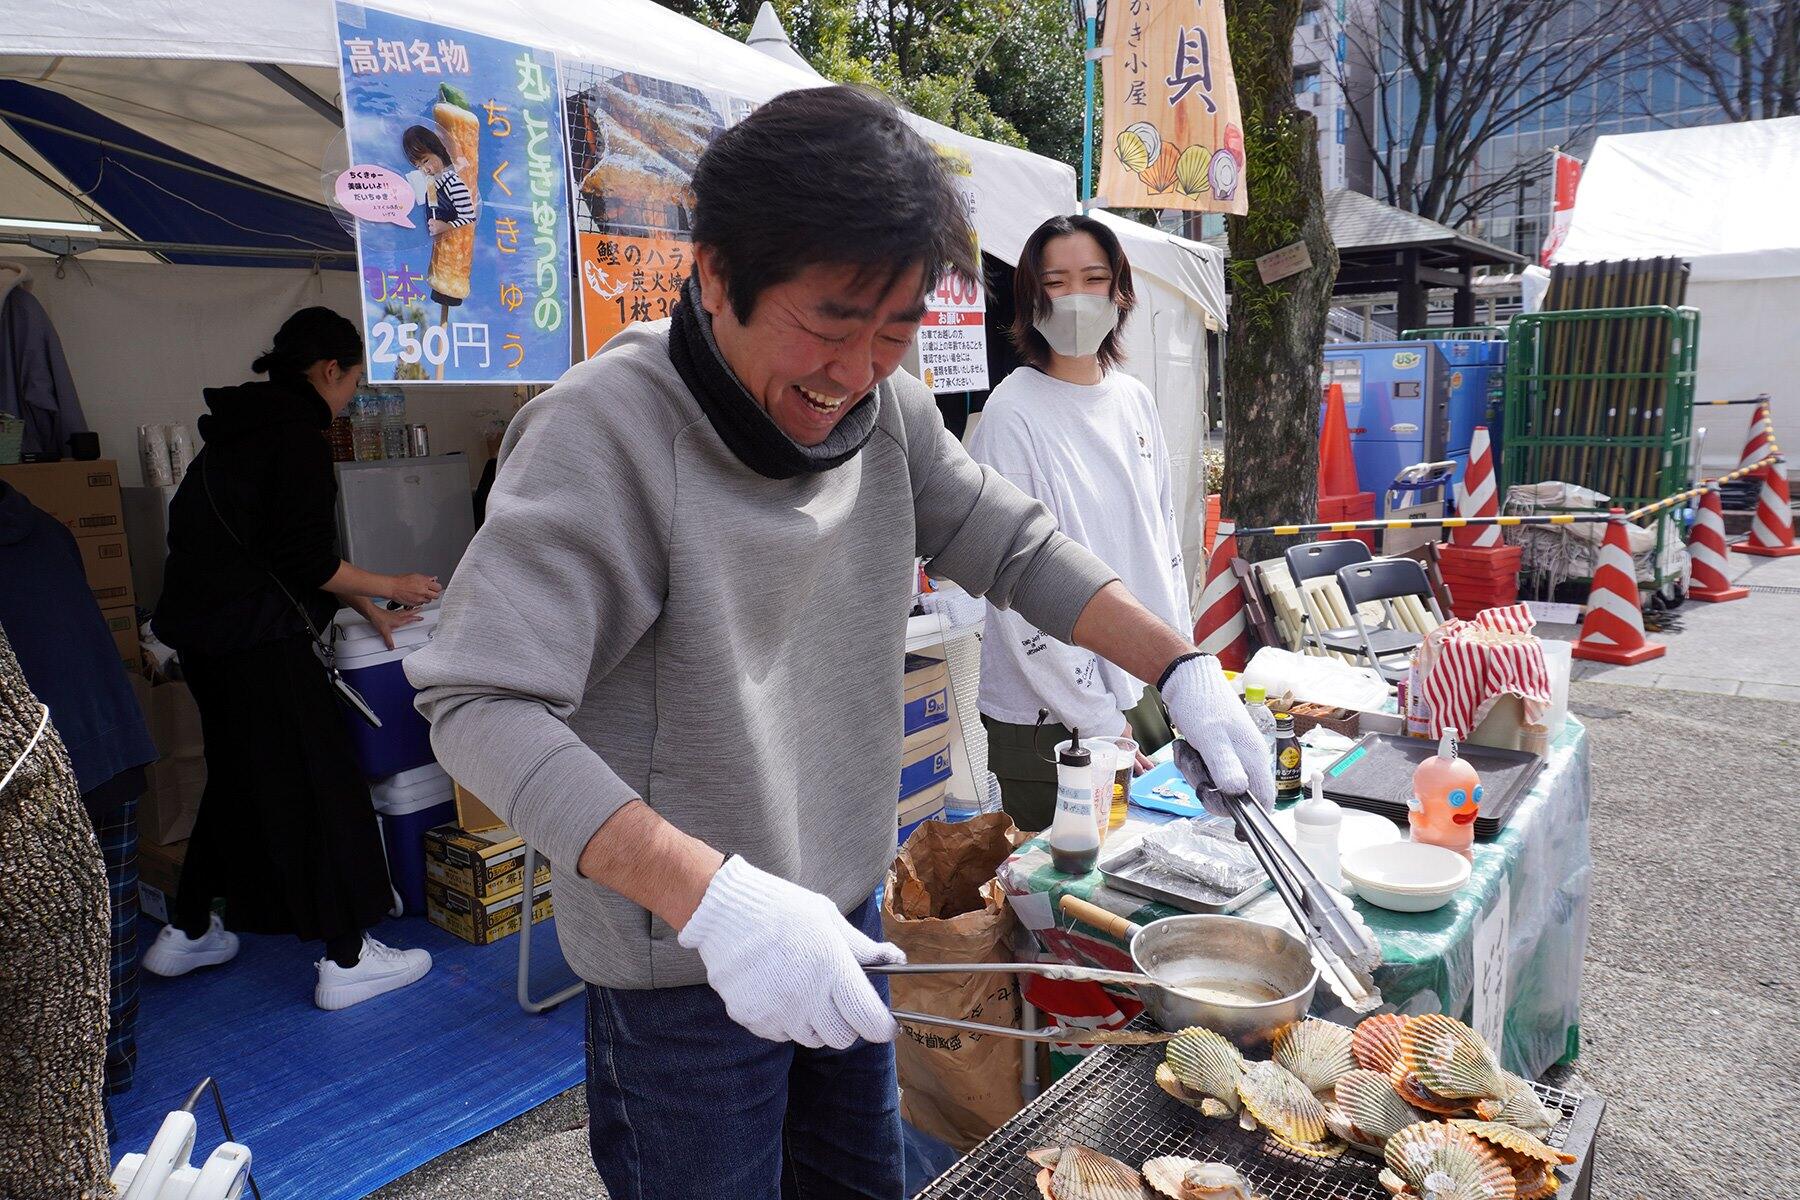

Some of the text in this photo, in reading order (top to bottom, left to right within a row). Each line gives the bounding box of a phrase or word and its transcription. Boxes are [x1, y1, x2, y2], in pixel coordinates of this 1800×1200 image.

[344, 37, 470, 75] 高知名物
[1166, 26, 1216, 113] 貝
[515, 53, 562, 331] 丸ごときゅうりの
[483, 98, 525, 369] ちくきゅう
[371, 321, 490, 368] 250円
[938, 312, 965, 325] お願い
